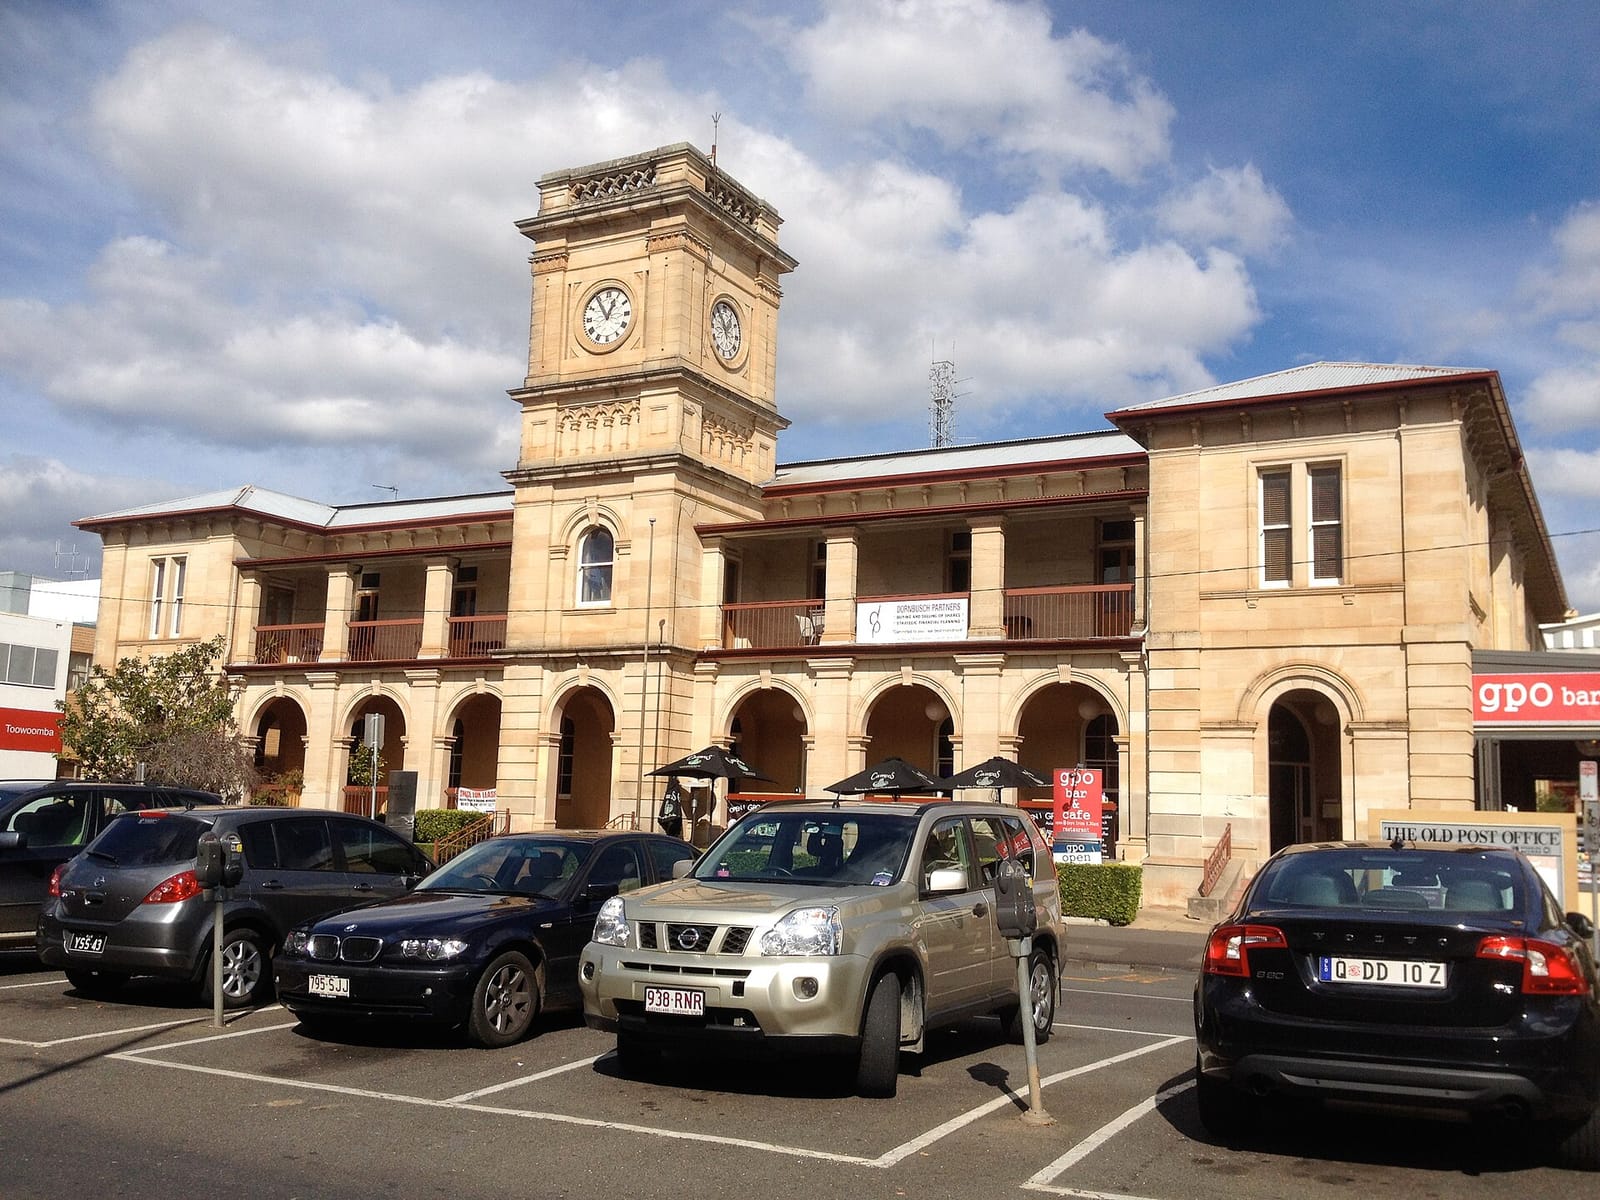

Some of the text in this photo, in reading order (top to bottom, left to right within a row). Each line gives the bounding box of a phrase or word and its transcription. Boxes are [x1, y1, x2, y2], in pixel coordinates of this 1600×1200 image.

[896, 602, 961, 613] DORNBUSCH PARTNERS
[1479, 682, 1600, 712] gpo bar
[5, 723, 55, 737] Toowoomba
[1060, 771, 1095, 787] gpo
[1065, 788, 1088, 798] bar
[1072, 799, 1080, 809] &
[1062, 809, 1091, 820] cafe
[1384, 826, 1560, 846] THE OLD POST OFFICE
[1066, 844, 1085, 853] gpo
[1062, 854, 1091, 864] open
